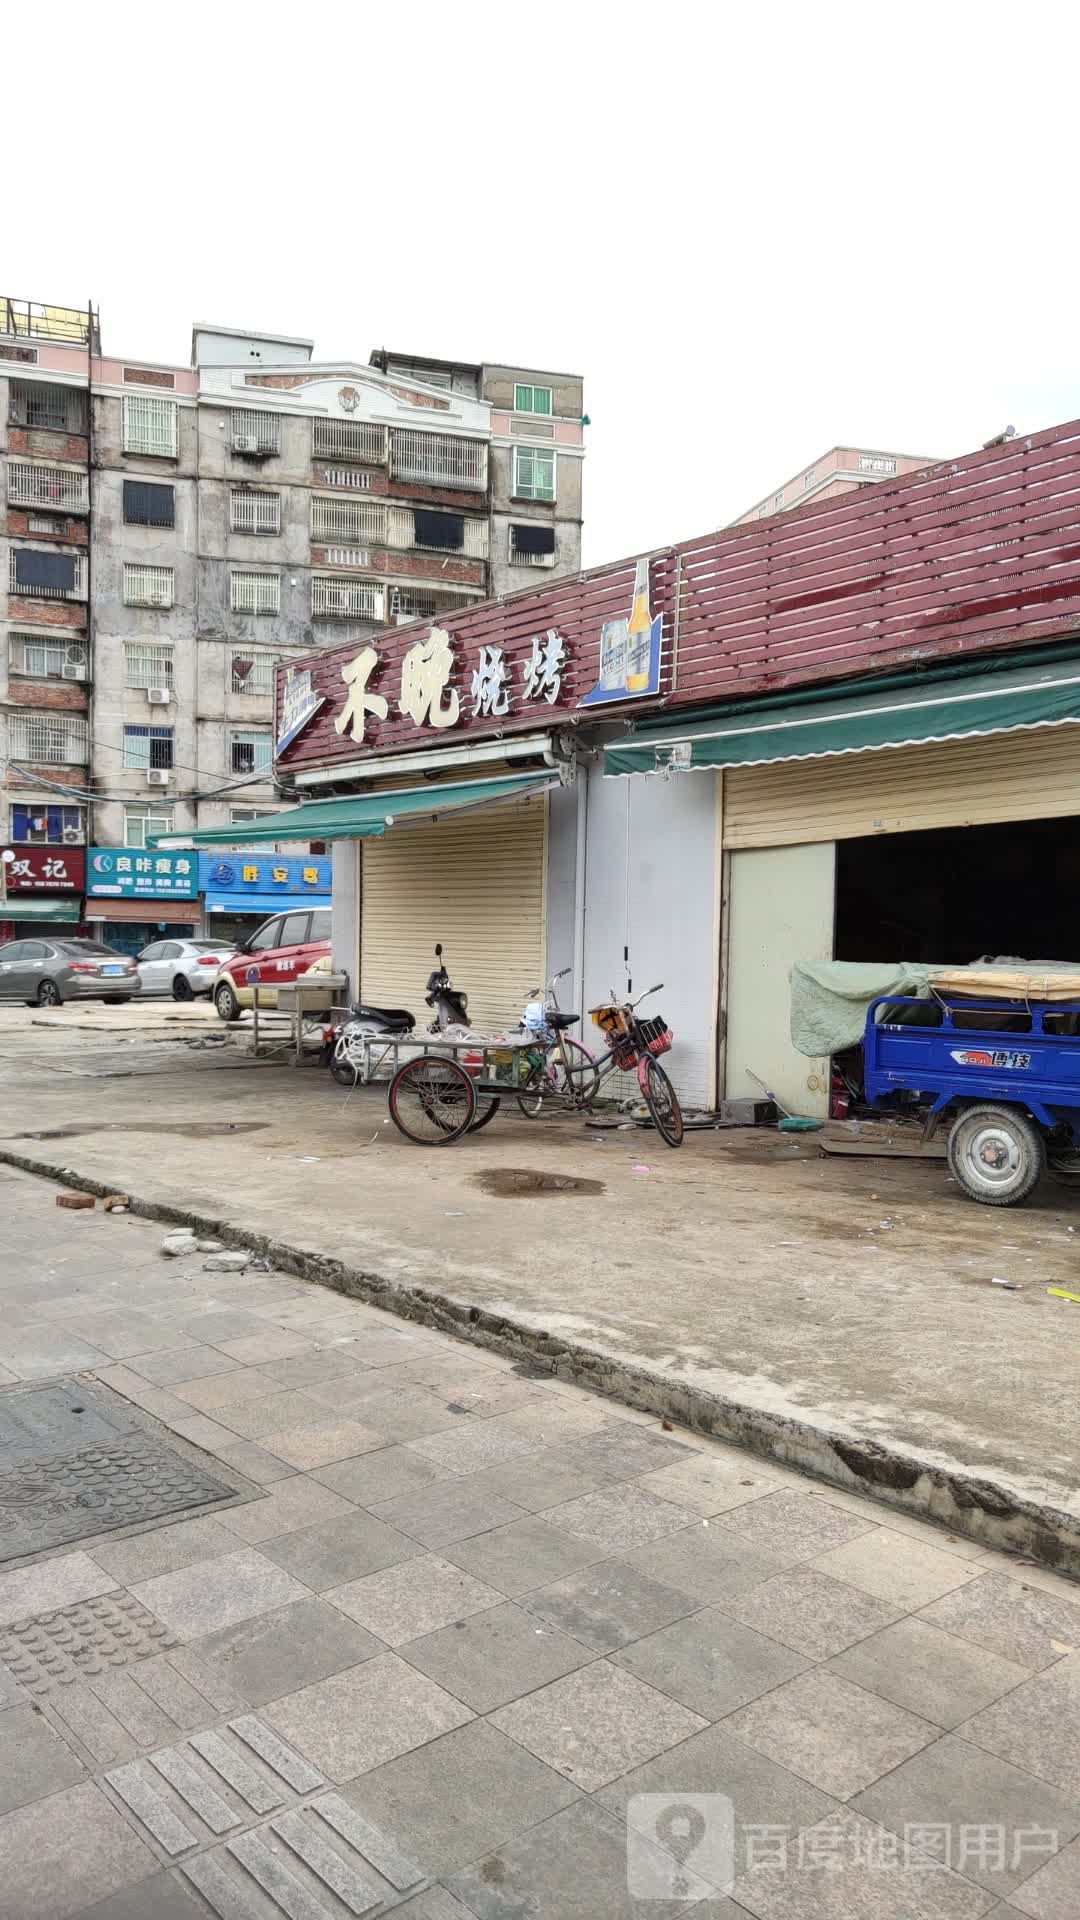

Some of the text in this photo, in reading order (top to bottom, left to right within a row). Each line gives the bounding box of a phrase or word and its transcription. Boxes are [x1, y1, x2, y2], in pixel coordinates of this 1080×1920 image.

[9, 857, 68, 878] 双记
[116, 856, 192, 875] 良咔瘦身
[991, 1051, 1030, 1069] 博技
